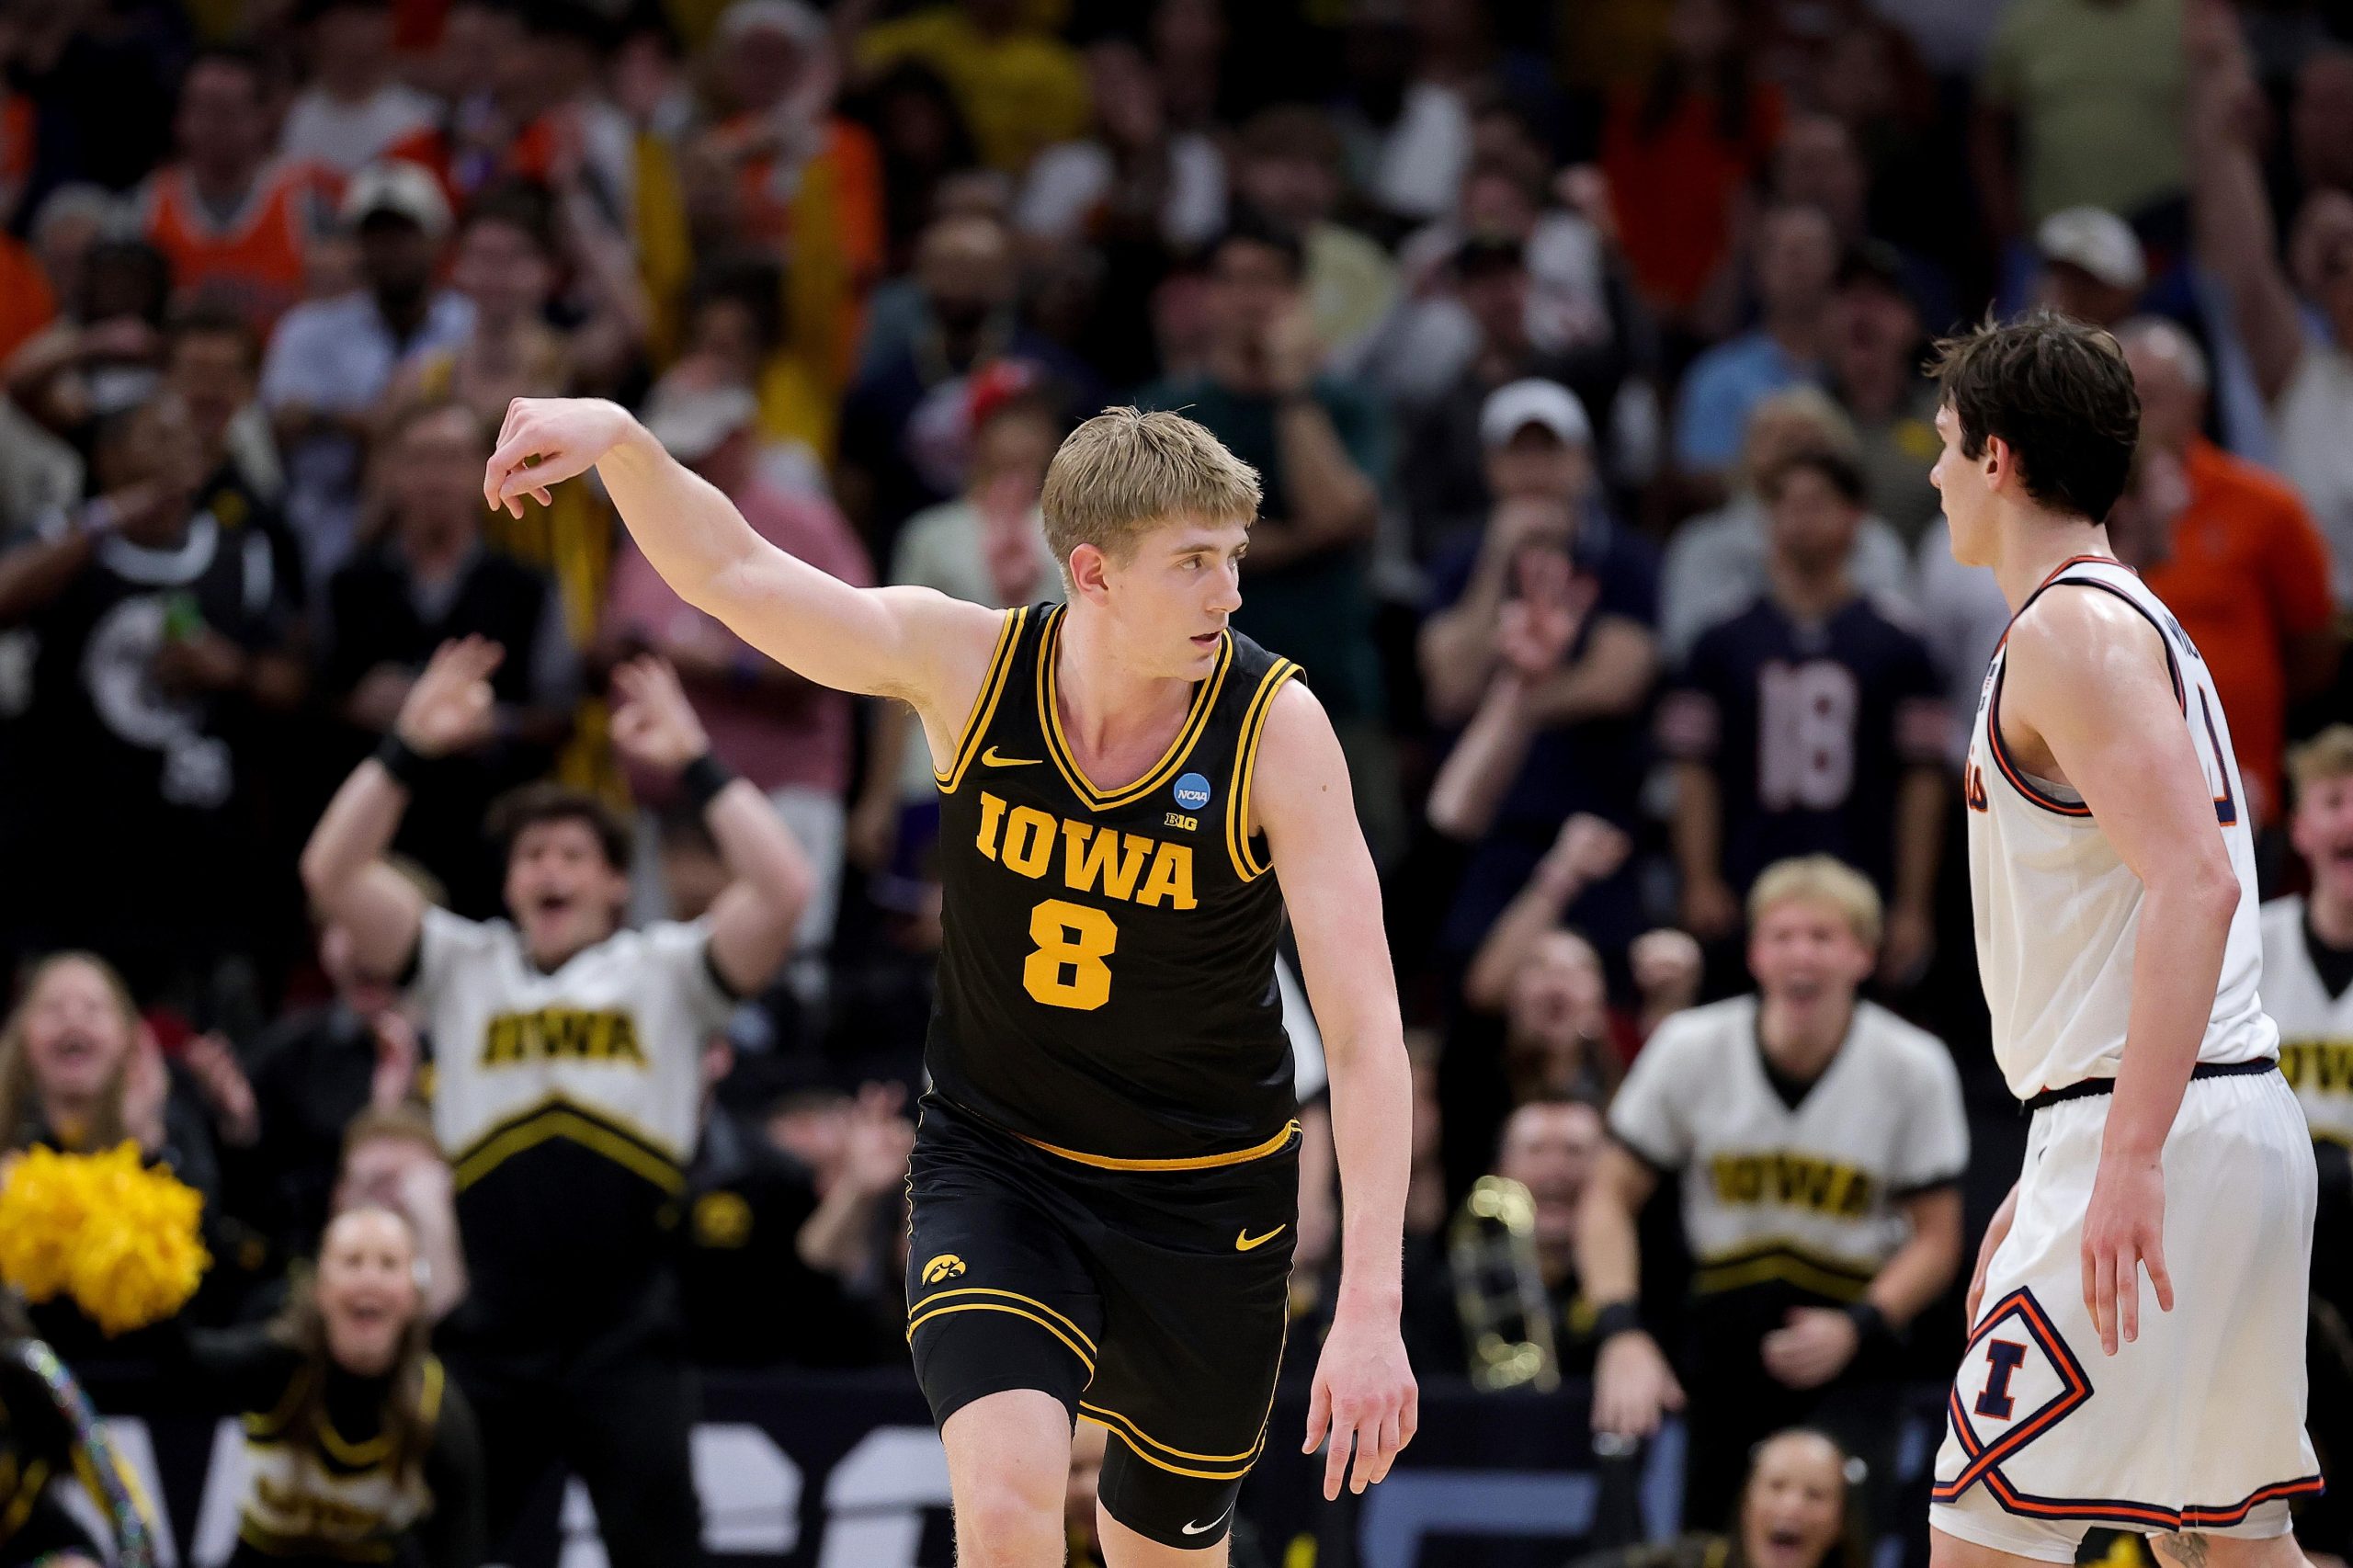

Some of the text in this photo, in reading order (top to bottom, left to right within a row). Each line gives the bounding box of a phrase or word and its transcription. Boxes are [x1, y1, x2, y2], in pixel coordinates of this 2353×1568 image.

[1177, 789, 1209, 803] NCAA
[976, 790, 1199, 911] IOWA
[1022, 898, 1119, 1011] 8
[1973, 1337, 2028, 1422] I
